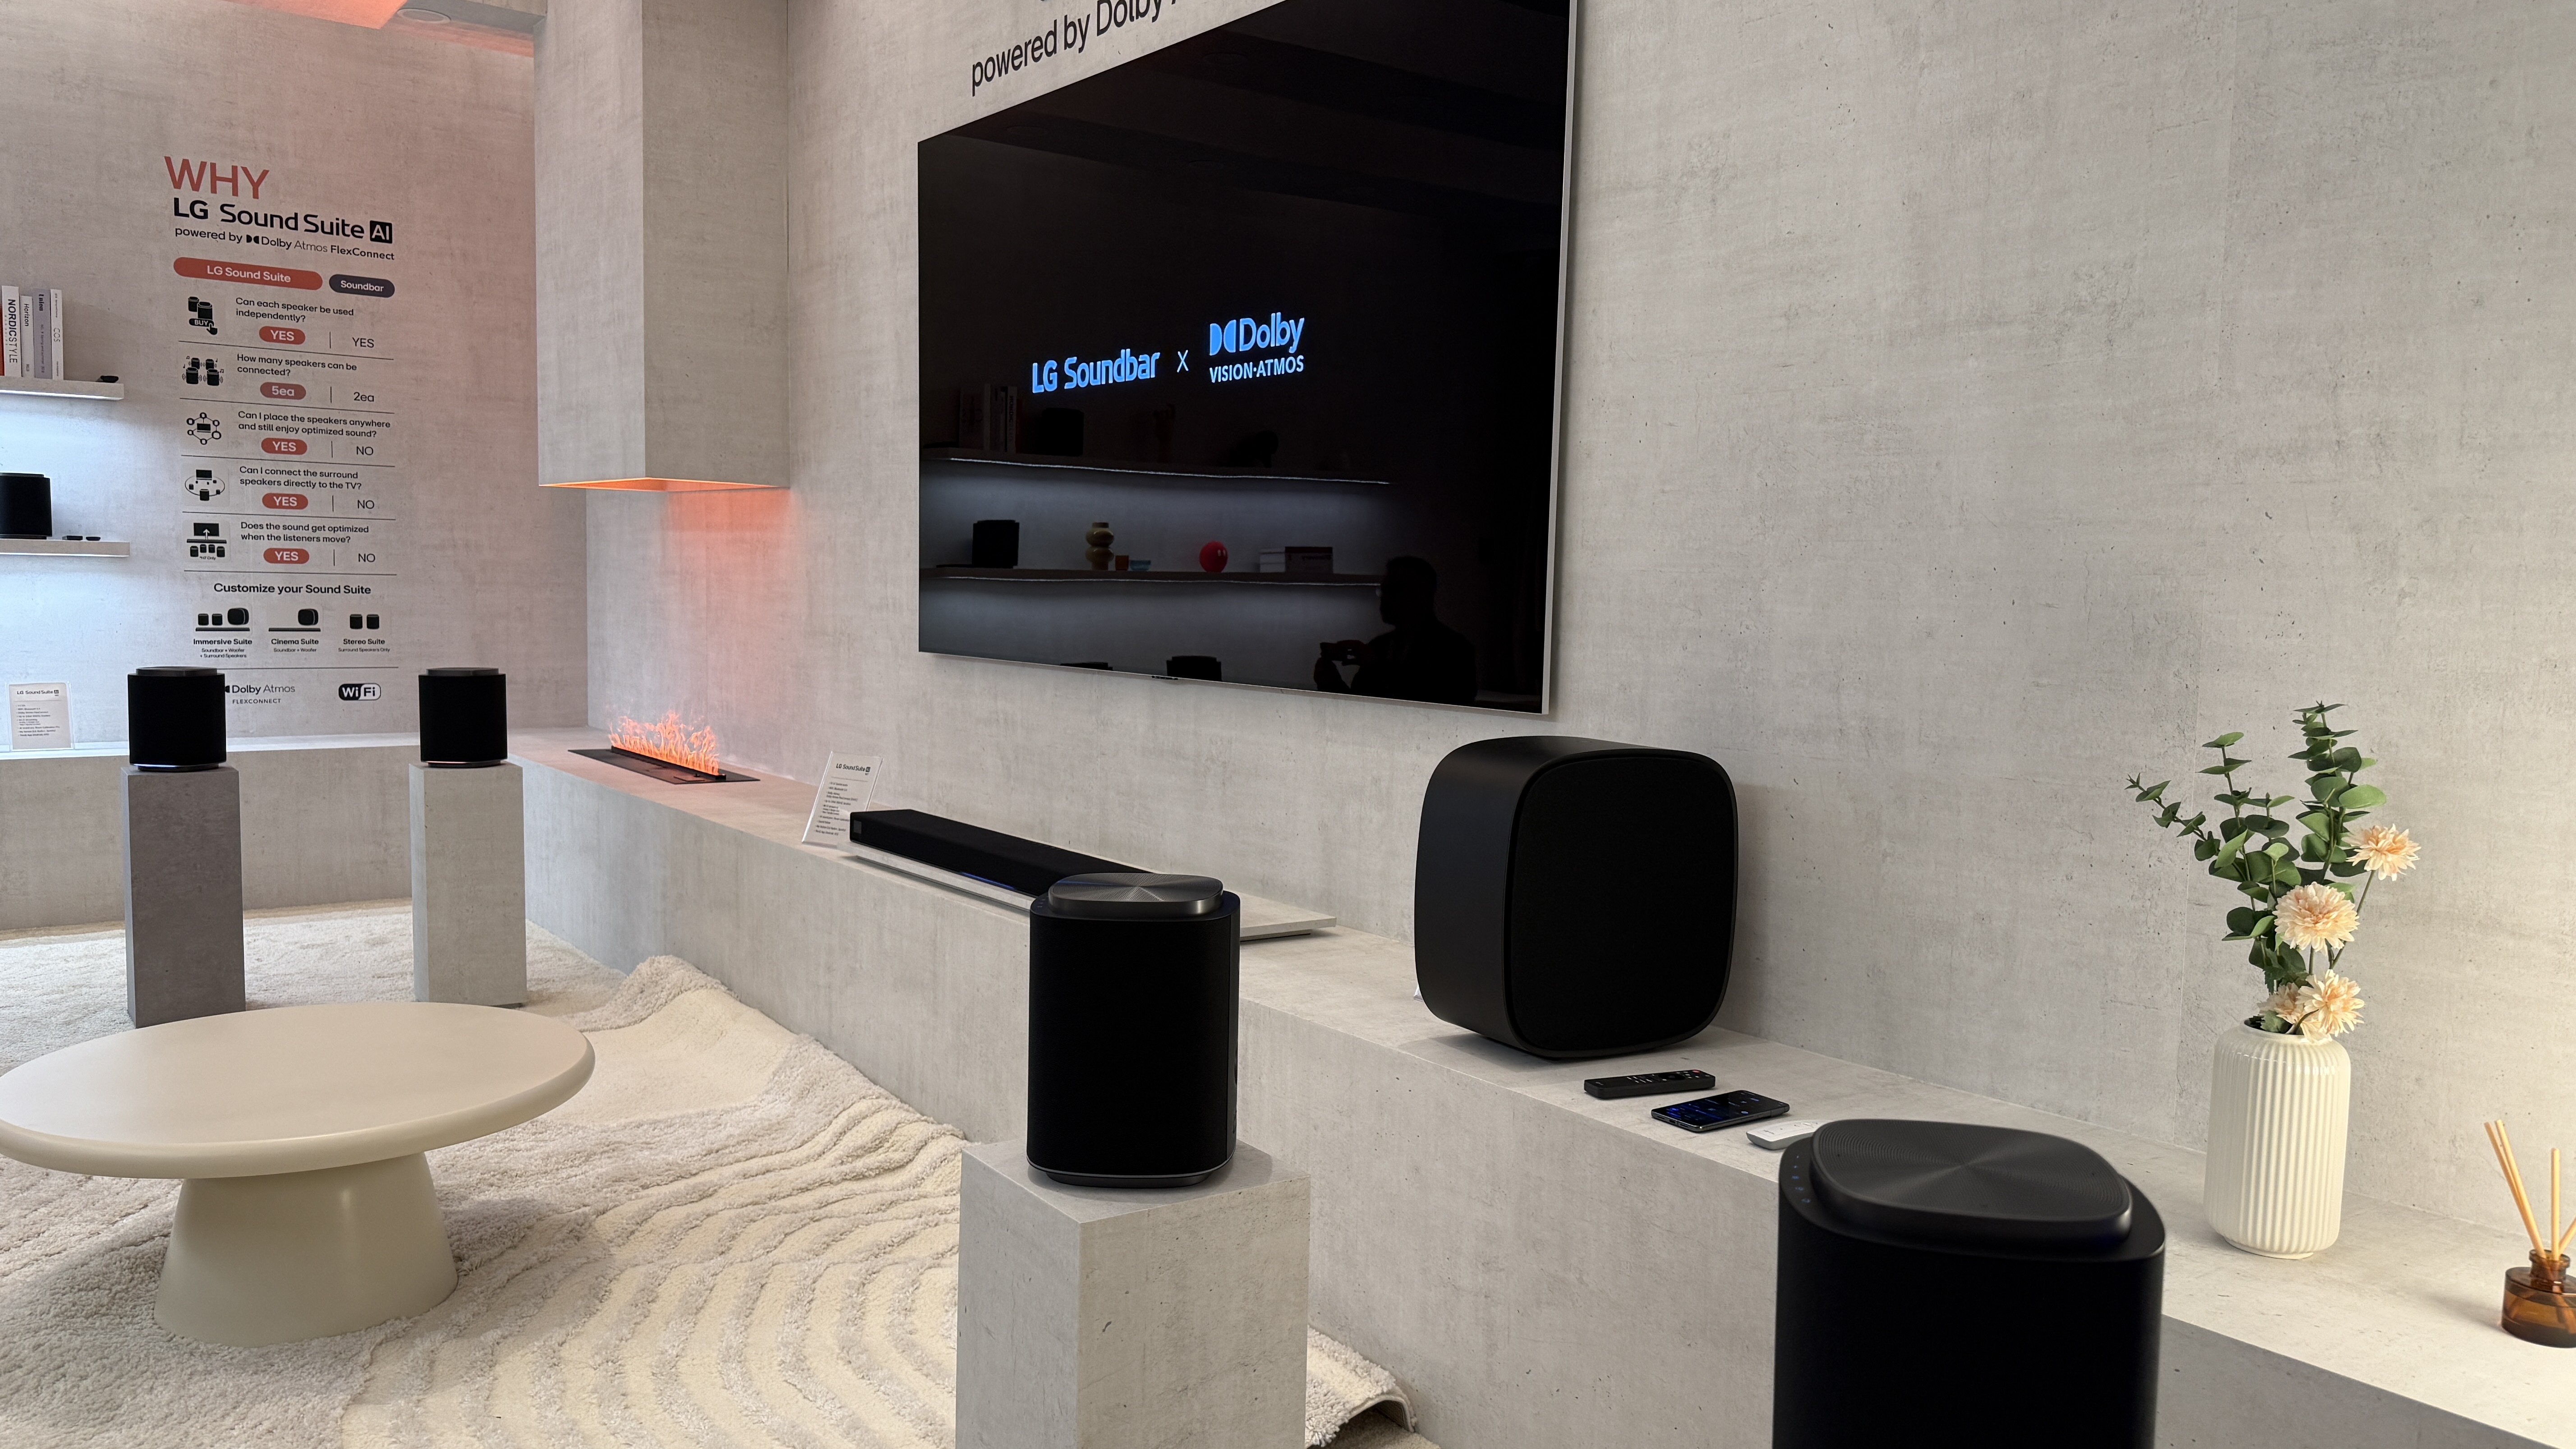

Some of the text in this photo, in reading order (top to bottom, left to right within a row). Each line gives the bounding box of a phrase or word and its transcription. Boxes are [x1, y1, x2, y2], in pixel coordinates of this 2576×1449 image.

[972, 19, 1057, 97] powered
[1064, 14, 1090, 54] by
[164, 156, 270, 200] WHY
[173, 197, 390, 242] LG Sound Suite AI
[175, 227, 395, 261] powered by Dolby Atmos FlexConnect
[207, 265, 291, 283] LG Sound Suite
[340, 280, 384, 292] Soundbar
[235, 297, 354, 316] Can each speaker be used
[236, 308, 306, 323] independently?
[270, 330, 294, 341] YES
[1239, 312, 1305, 354] Dolby
[352, 337, 375, 348] YES
[237, 354, 257, 362] How
[258, 356, 283, 366] many
[285, 359, 326, 369] speakers
[237, 365, 291, 377] connected?
[1032, 349, 1160, 393] LG Soundbar
[271, 386, 295, 397] 5ea
[353, 392, 375, 402] 2ea
[238, 411, 258, 419] Can
[263, 413, 289, 422] place
[307, 415, 347, 425] speakers
[349, 418, 391, 428] anywhere
[258, 423, 274, 432] still
[276, 425, 300, 434] enjoy
[301, 426, 344, 436] optimized
[345, 428, 377, 437] sound?
[272, 442, 297, 451] YES
[356, 446, 374, 455] NO
[265, 468, 301, 476] connect
[319, 470, 358, 479] surround
[239, 478, 281, 487] speakers
[283, 479, 316, 488] directly
[345, 482, 362, 490] TV?
[273, 497, 298, 506] YES
[357, 500, 375, 509] NO
[240, 522, 369, 534] Does the sound get optimized
[283, 534, 321, 542] listeners
[274, 552, 299, 561] YES
[358, 553, 376, 562] NO
[213, 583, 371, 594] Customize your Sound Suite
[232, 685, 295, 695] Dolby Atmos
